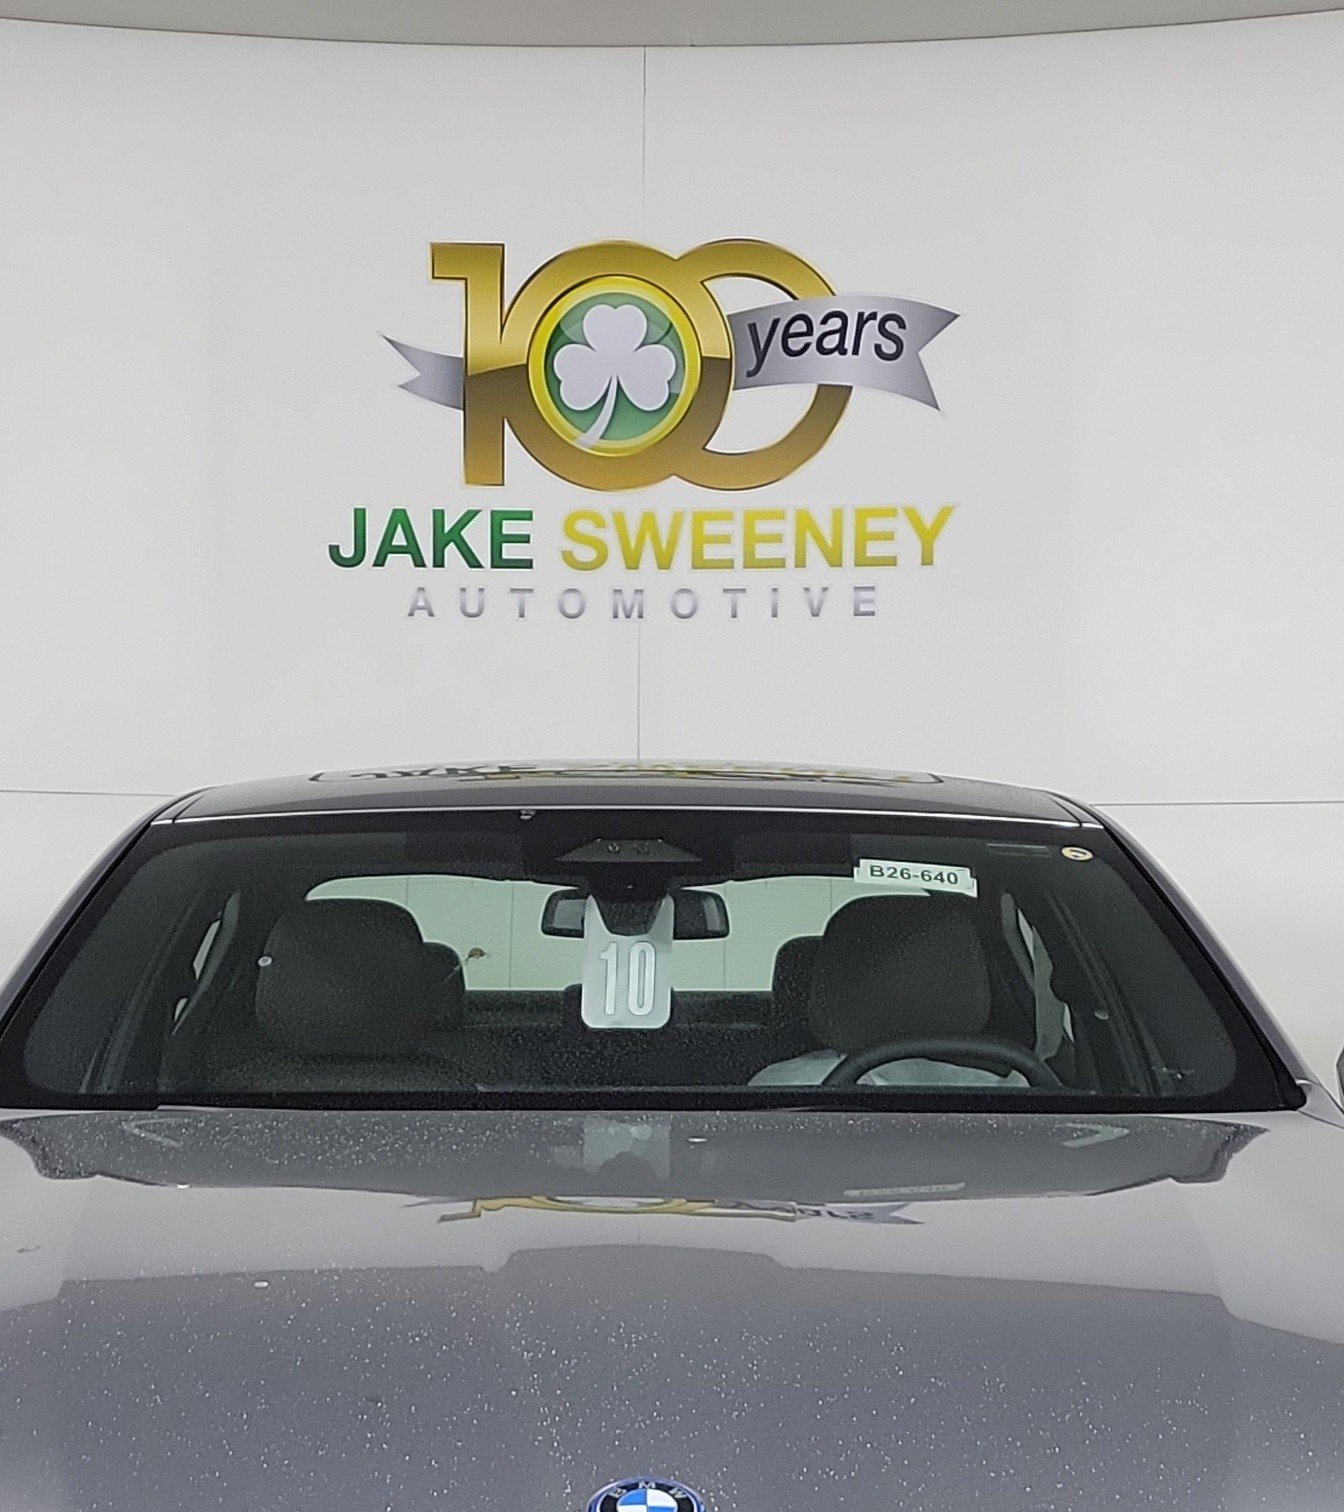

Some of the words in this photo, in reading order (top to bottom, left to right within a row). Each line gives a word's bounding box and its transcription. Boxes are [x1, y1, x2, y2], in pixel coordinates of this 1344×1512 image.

[430, 238, 854, 492] 100
[745, 308, 908, 379] years
[327, 506, 535, 571] JAKE
[560, 504, 955, 573] SWEENEY
[406, 584, 878, 621] AUTOMOTIVE
[869, 864, 959, 885] B26-640
[599, 940, 657, 1017] 10
